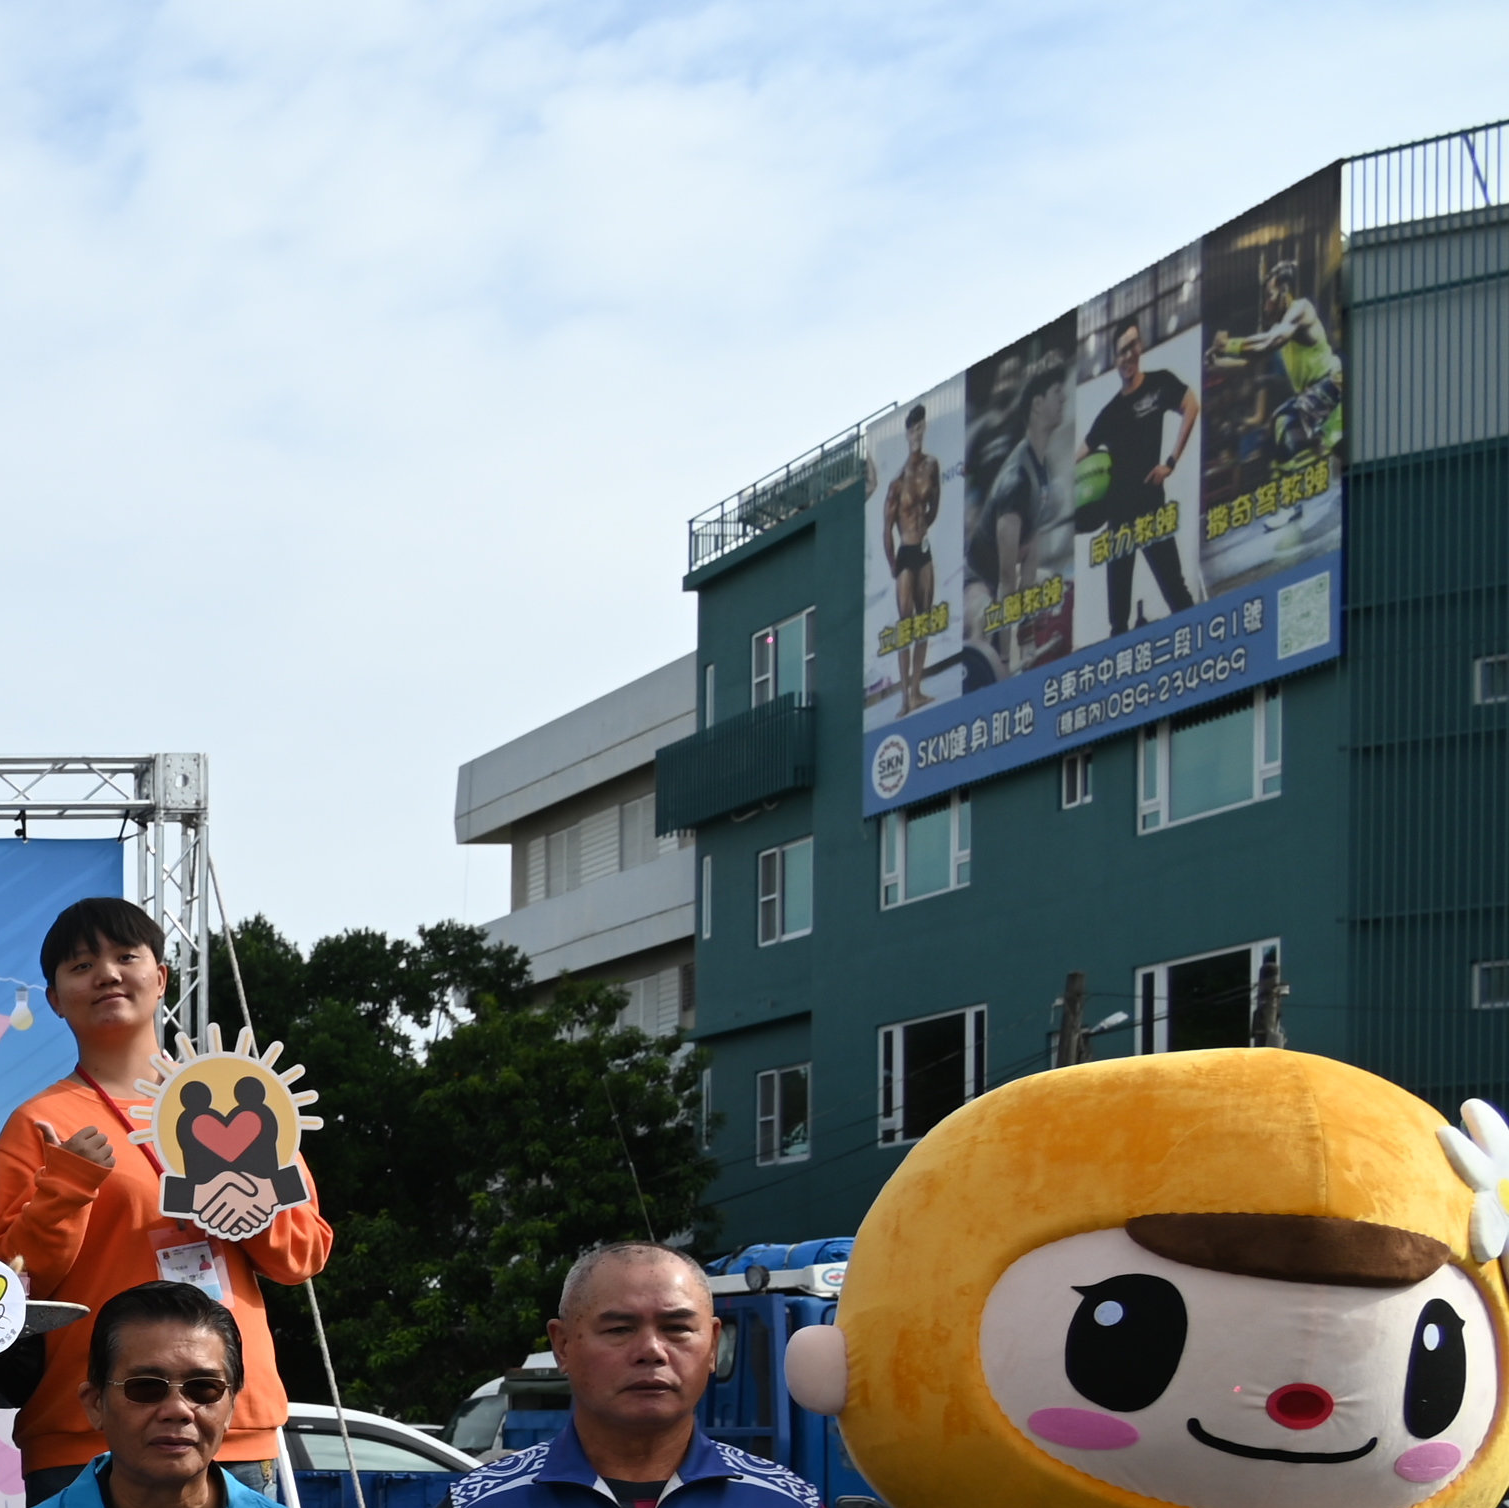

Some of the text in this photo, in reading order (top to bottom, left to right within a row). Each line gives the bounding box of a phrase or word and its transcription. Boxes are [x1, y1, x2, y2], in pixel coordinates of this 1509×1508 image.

[1042, 598, 1263, 708] 台東市中興路二段191號
[878, 753, 904, 773] SKN
